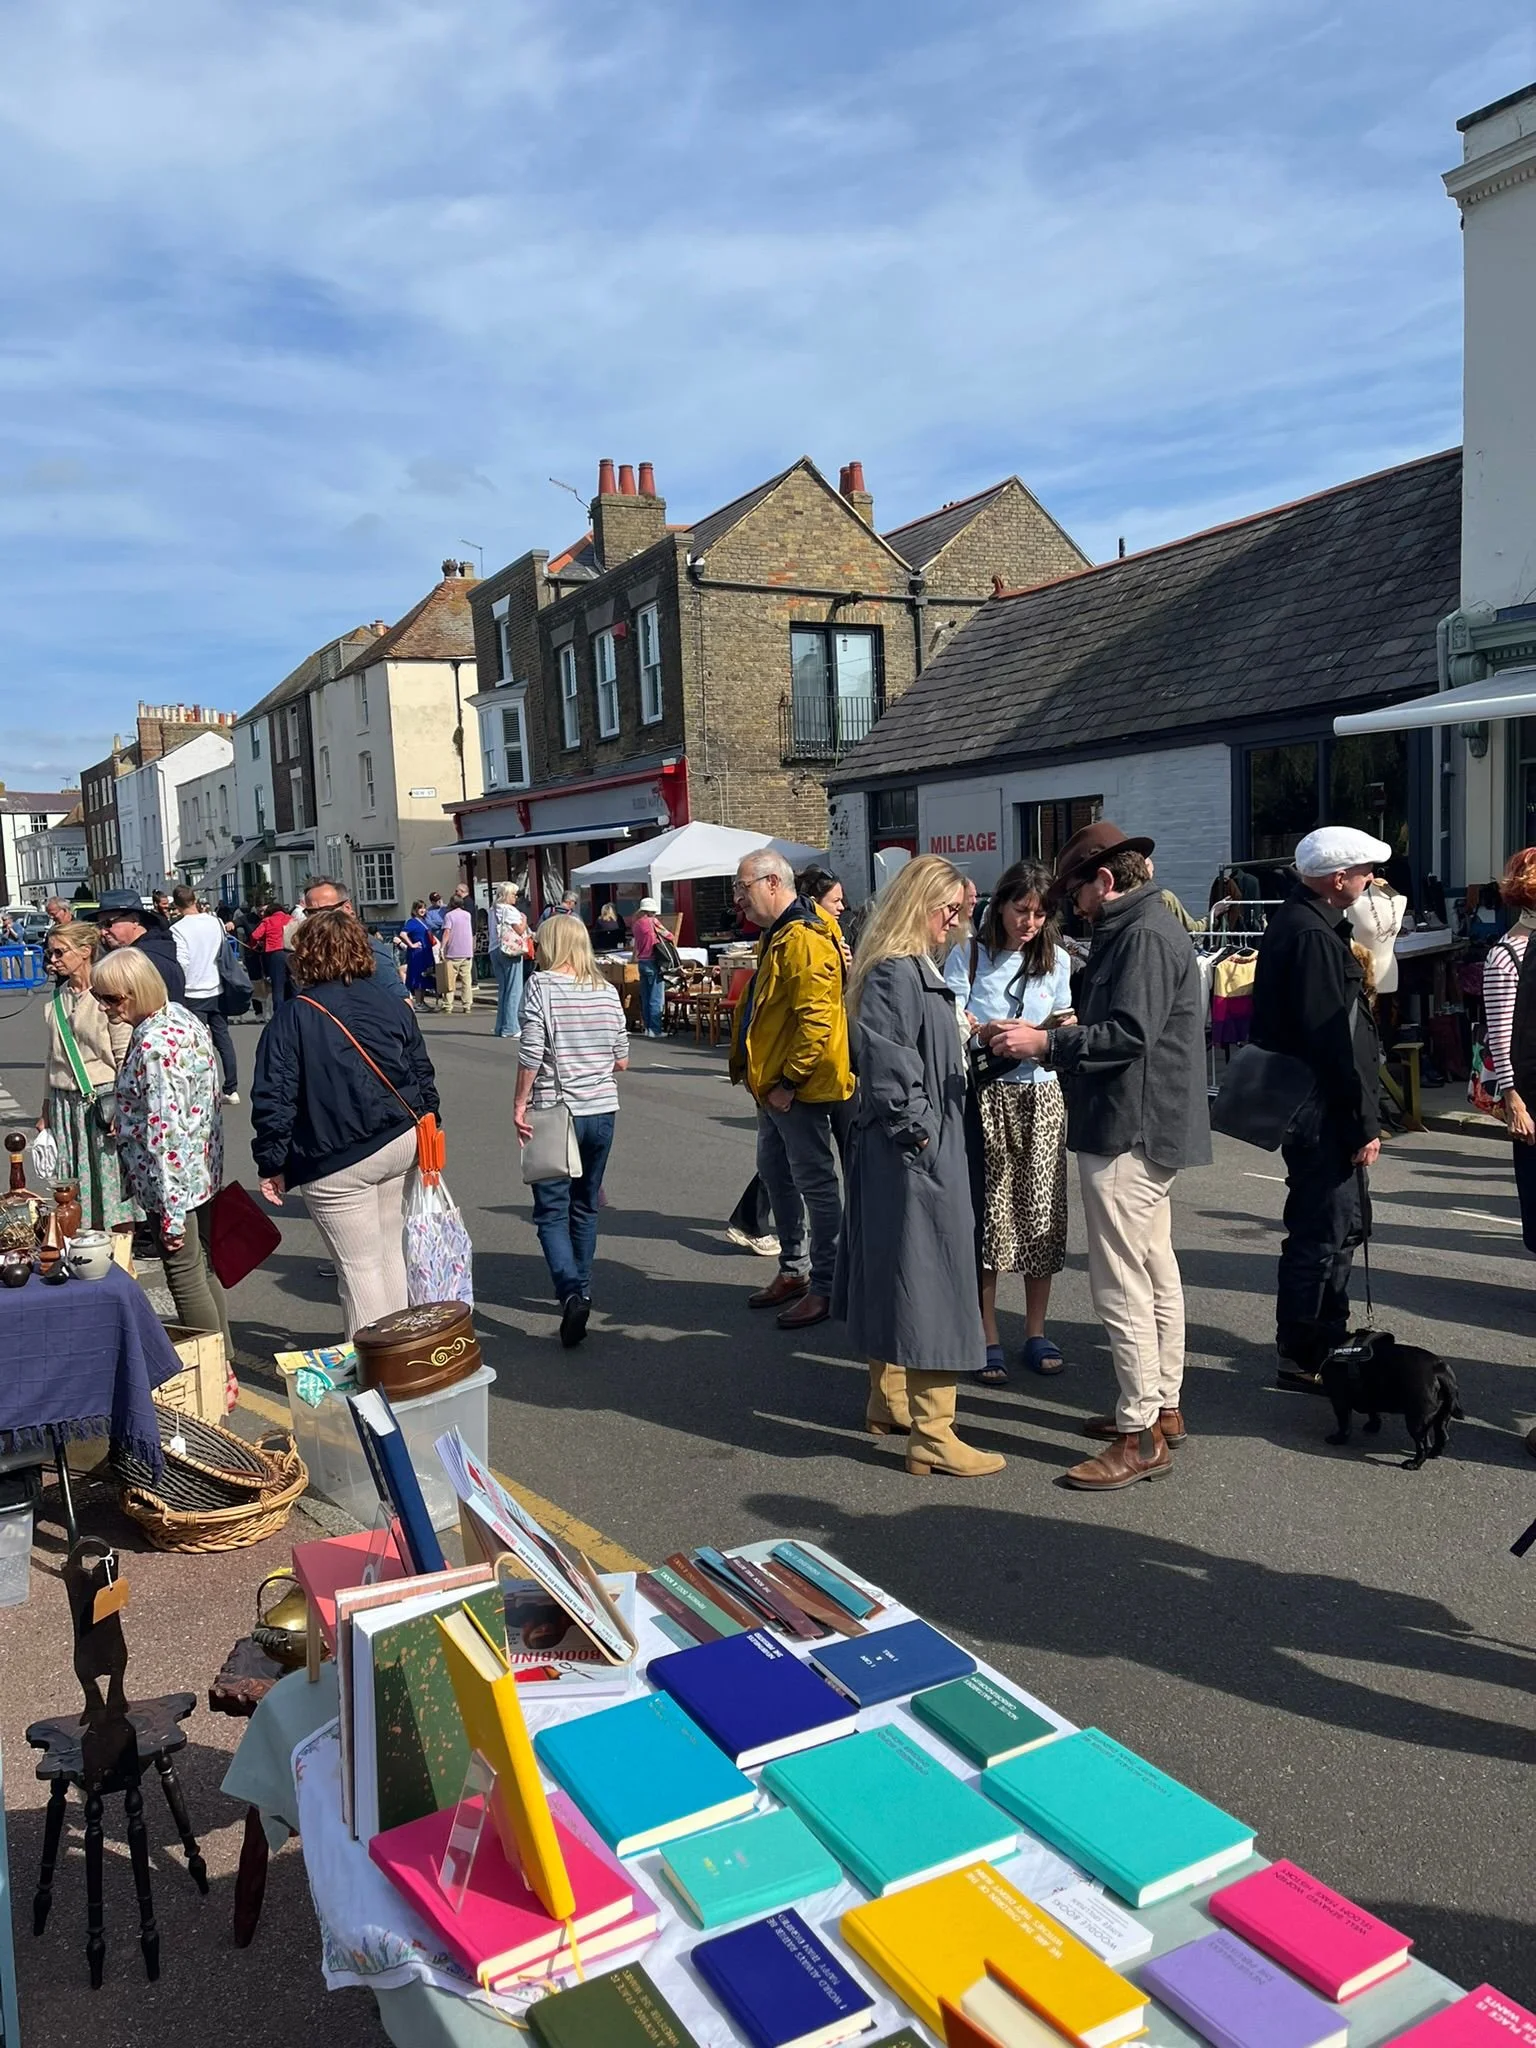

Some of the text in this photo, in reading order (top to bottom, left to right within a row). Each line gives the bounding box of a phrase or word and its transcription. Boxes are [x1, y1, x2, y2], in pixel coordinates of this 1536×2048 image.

[930, 832, 997, 854] MILEAGE
[859, 1655, 872, 1665] CAN
[1052, 1898, 1080, 1919] BOOKS
[1272, 1871, 1367, 1935] WELL BEHAVED WOMEN
[1278, 1867, 1373, 1930] SELDOM MAKE HISTORY
[765, 1916, 778, 1928] BE
[964, 1870, 1063, 1959] WE ARE THE CHILDREN OF THE
[774, 1926, 798, 1952] RATHER
[1079, 1920, 1117, 1950] WOODLE
[776, 1913, 840, 1985] HAPPY THAN DIGNIFIED
[794, 1950, 821, 1977] ALWAYS
[818, 1979, 842, 2004] WOULD
[1475, 2001, 1521, 2034] PLACE IS
[1484, 1995, 1520, 2023] WANTS
